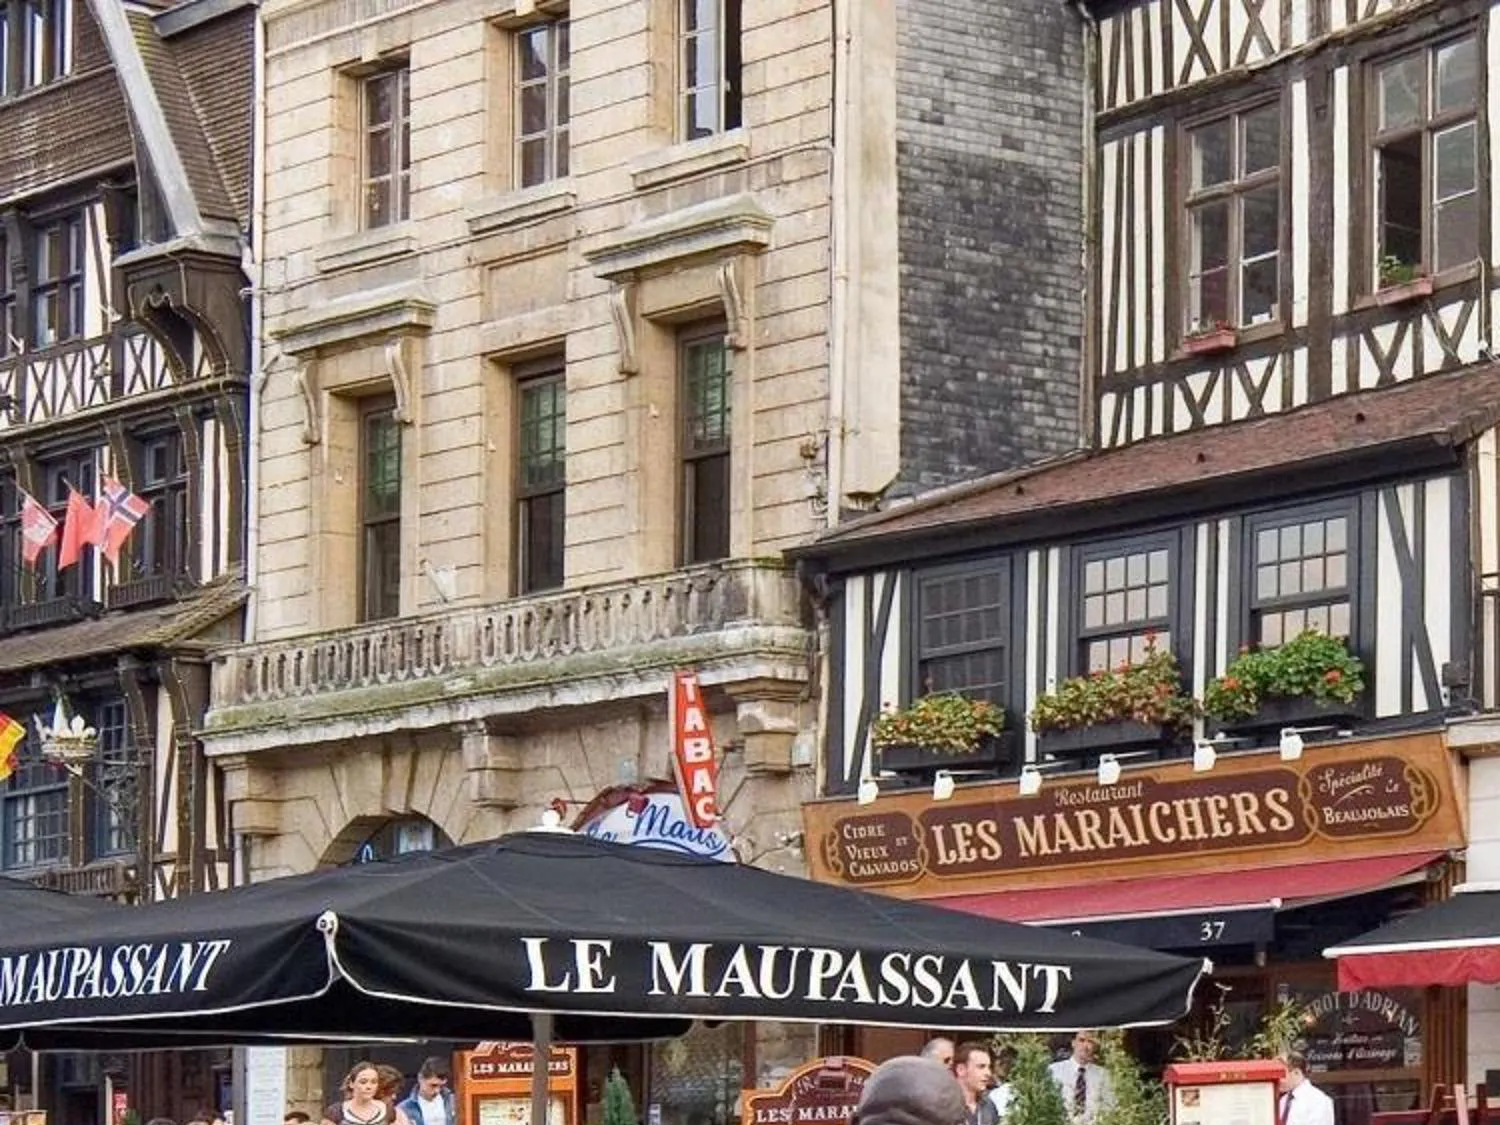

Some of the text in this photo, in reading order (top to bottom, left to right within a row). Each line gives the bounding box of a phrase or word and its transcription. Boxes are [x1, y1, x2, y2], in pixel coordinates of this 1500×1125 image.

[681, 677, 716, 821] TABAC
[1055, 781, 1143, 808] Restaurant
[1323, 805, 1409, 825] BEAUJOLAIS
[843, 823, 885, 840] CIDRE
[931, 788, 1295, 866] LES MARAICHERS
[846, 844, 889, 860] VIEUX
[849, 857, 919, 877] CALVADOS
[1200, 921, 1225, 941] 37
[0, 940, 231, 1007] MAUPASSANT
[521, 937, 1072, 1014] LE MAUPASSANT
[473, 1063, 494, 1074] LES
[756, 1109, 790, 1123] LES
